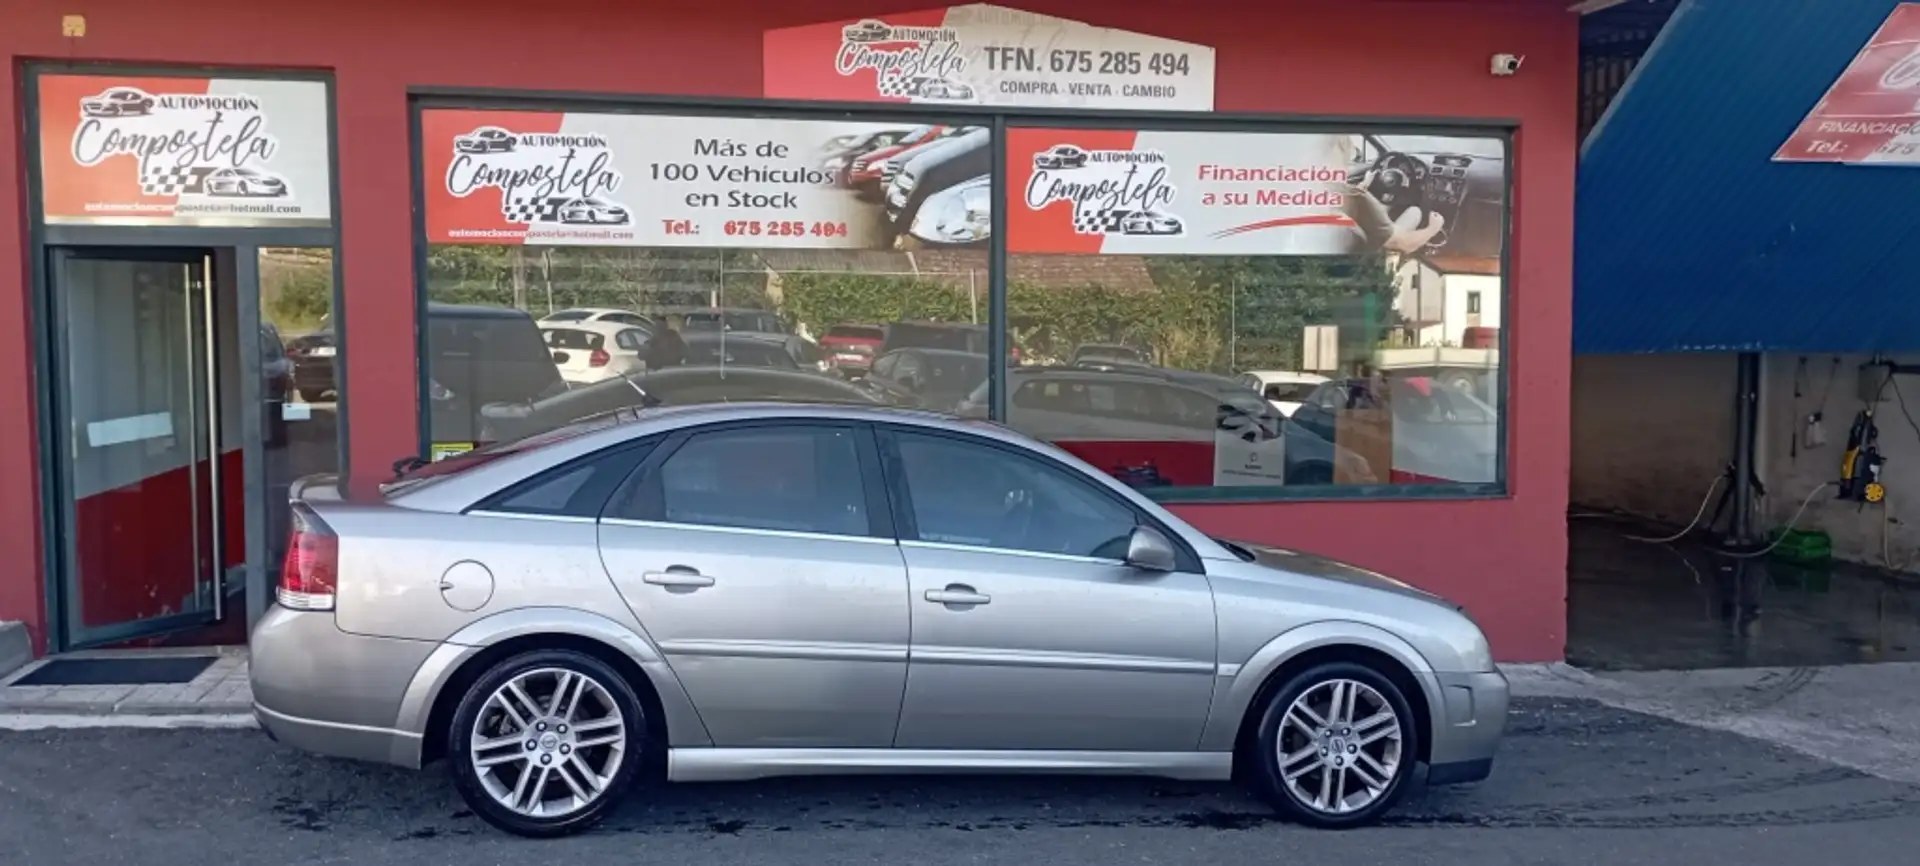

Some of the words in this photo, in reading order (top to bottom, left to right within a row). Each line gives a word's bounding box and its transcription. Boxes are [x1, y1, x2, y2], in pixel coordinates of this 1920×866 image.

[893, 28, 956, 41] AUTOMOCIÓN
[838, 40, 967, 80] Compostela
[984, 47, 1042, 72] TFN.
[1050, 49, 1092, 73] 675
[1099, 51, 1141, 75] 285
[1148, 52, 1190, 77] 494
[1000, 80, 1058, 95] COMPRA
[1068, 82, 1112, 97] VENTA
[1122, 84, 1176, 98] CAMBIO
[157, 94, 259, 111] AUTOMOCIÓN
[73, 112, 275, 174] Compostela
[519, 133, 607, 148] AUTOMOCIÓN
[693, 137, 747, 157] Más
[755, 139, 789, 158] de
[1090, 149, 1165, 164] AUTOMOCIÓN
[449, 148, 620, 205] Compostela
[650, 162, 699, 181] 100
[706, 163, 835, 185] Vehículos
[1198, 163, 1348, 183] Financiación
[1027, 164, 1176, 213] Compostela
[1201, 194, 1216, 206] a
[1223, 193, 1249, 206] su
[1256, 188, 1343, 207] Medida
[685, 192, 719, 208] en
[727, 189, 798, 209] Stock
[662, 219, 700, 235] Tel.:
[724, 219, 762, 236] 675
[767, 221, 805, 237] 285
[810, 221, 848, 238] 494
